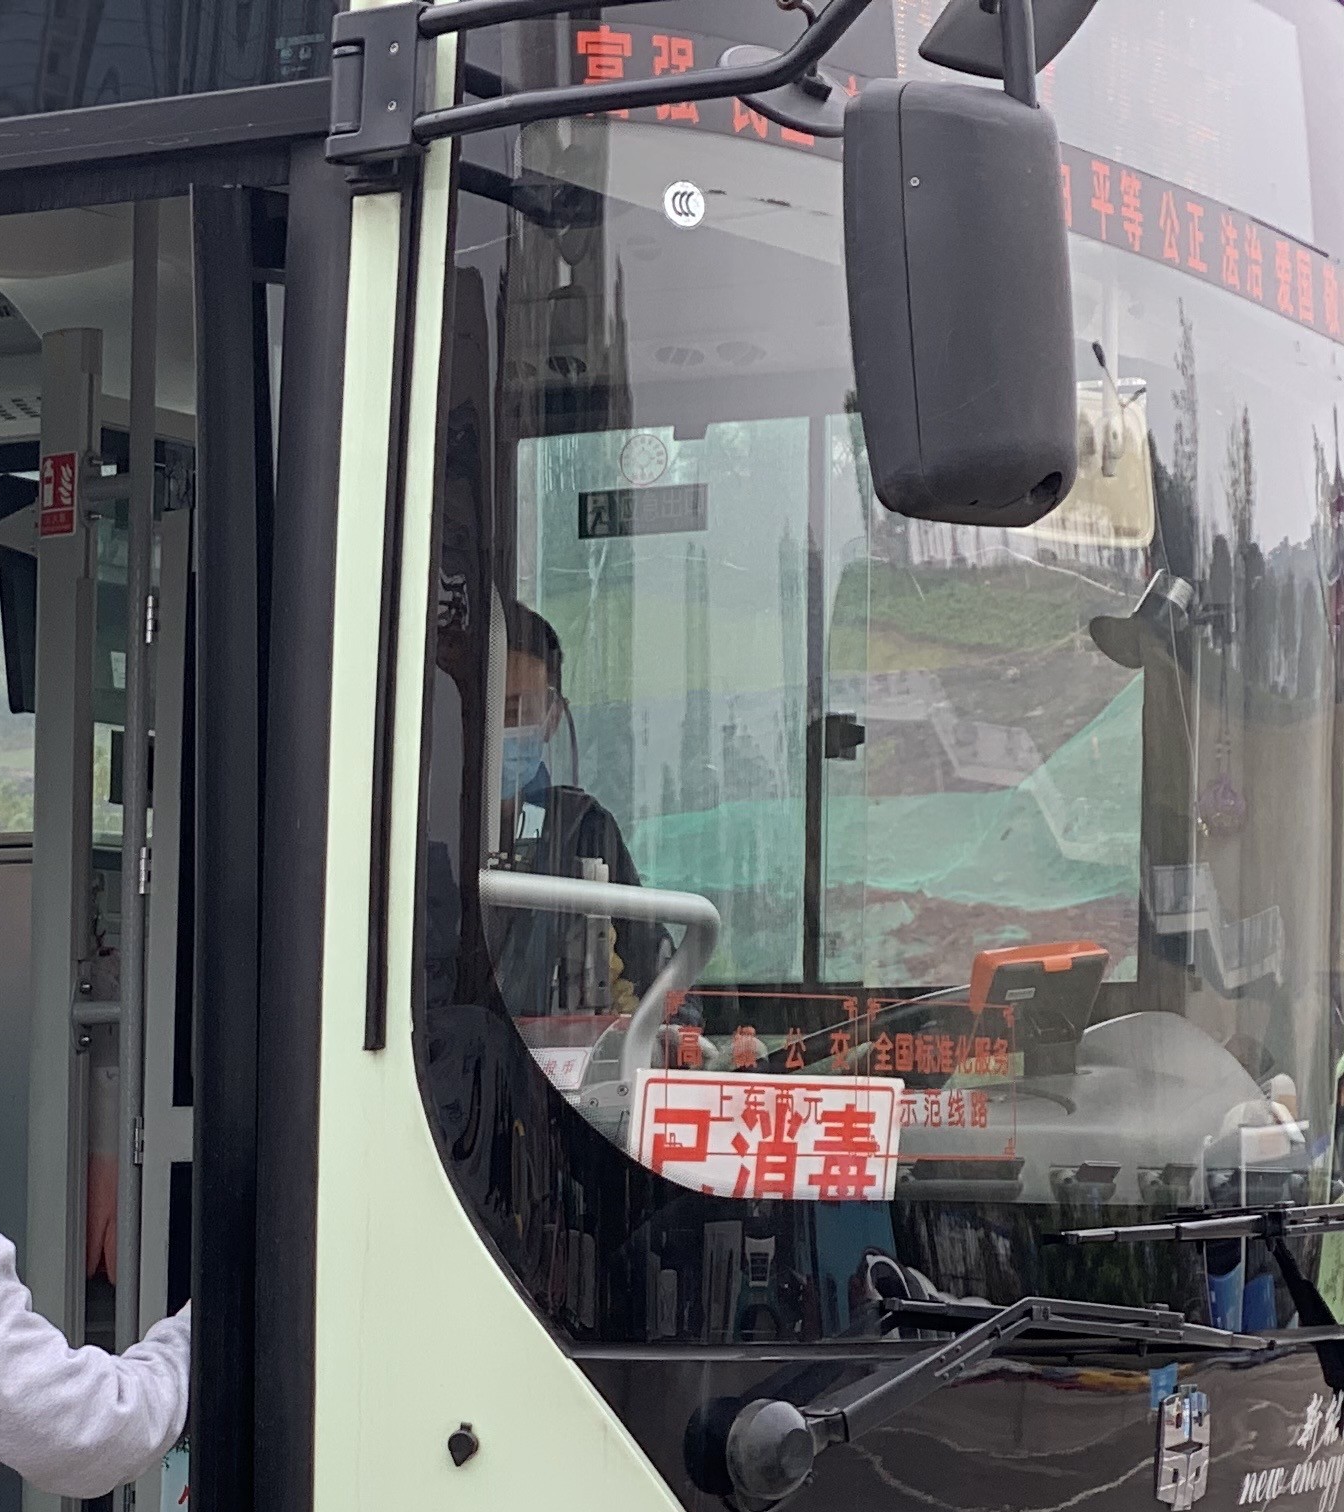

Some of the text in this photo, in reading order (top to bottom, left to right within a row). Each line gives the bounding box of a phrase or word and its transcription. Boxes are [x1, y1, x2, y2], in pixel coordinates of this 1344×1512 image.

[1090, 159, 1144, 252] 平等
[1159, 190, 1208, 273] 公正
[1220, 213, 1263, 301] 法治
[898, 1088, 988, 1129] 示范线路
